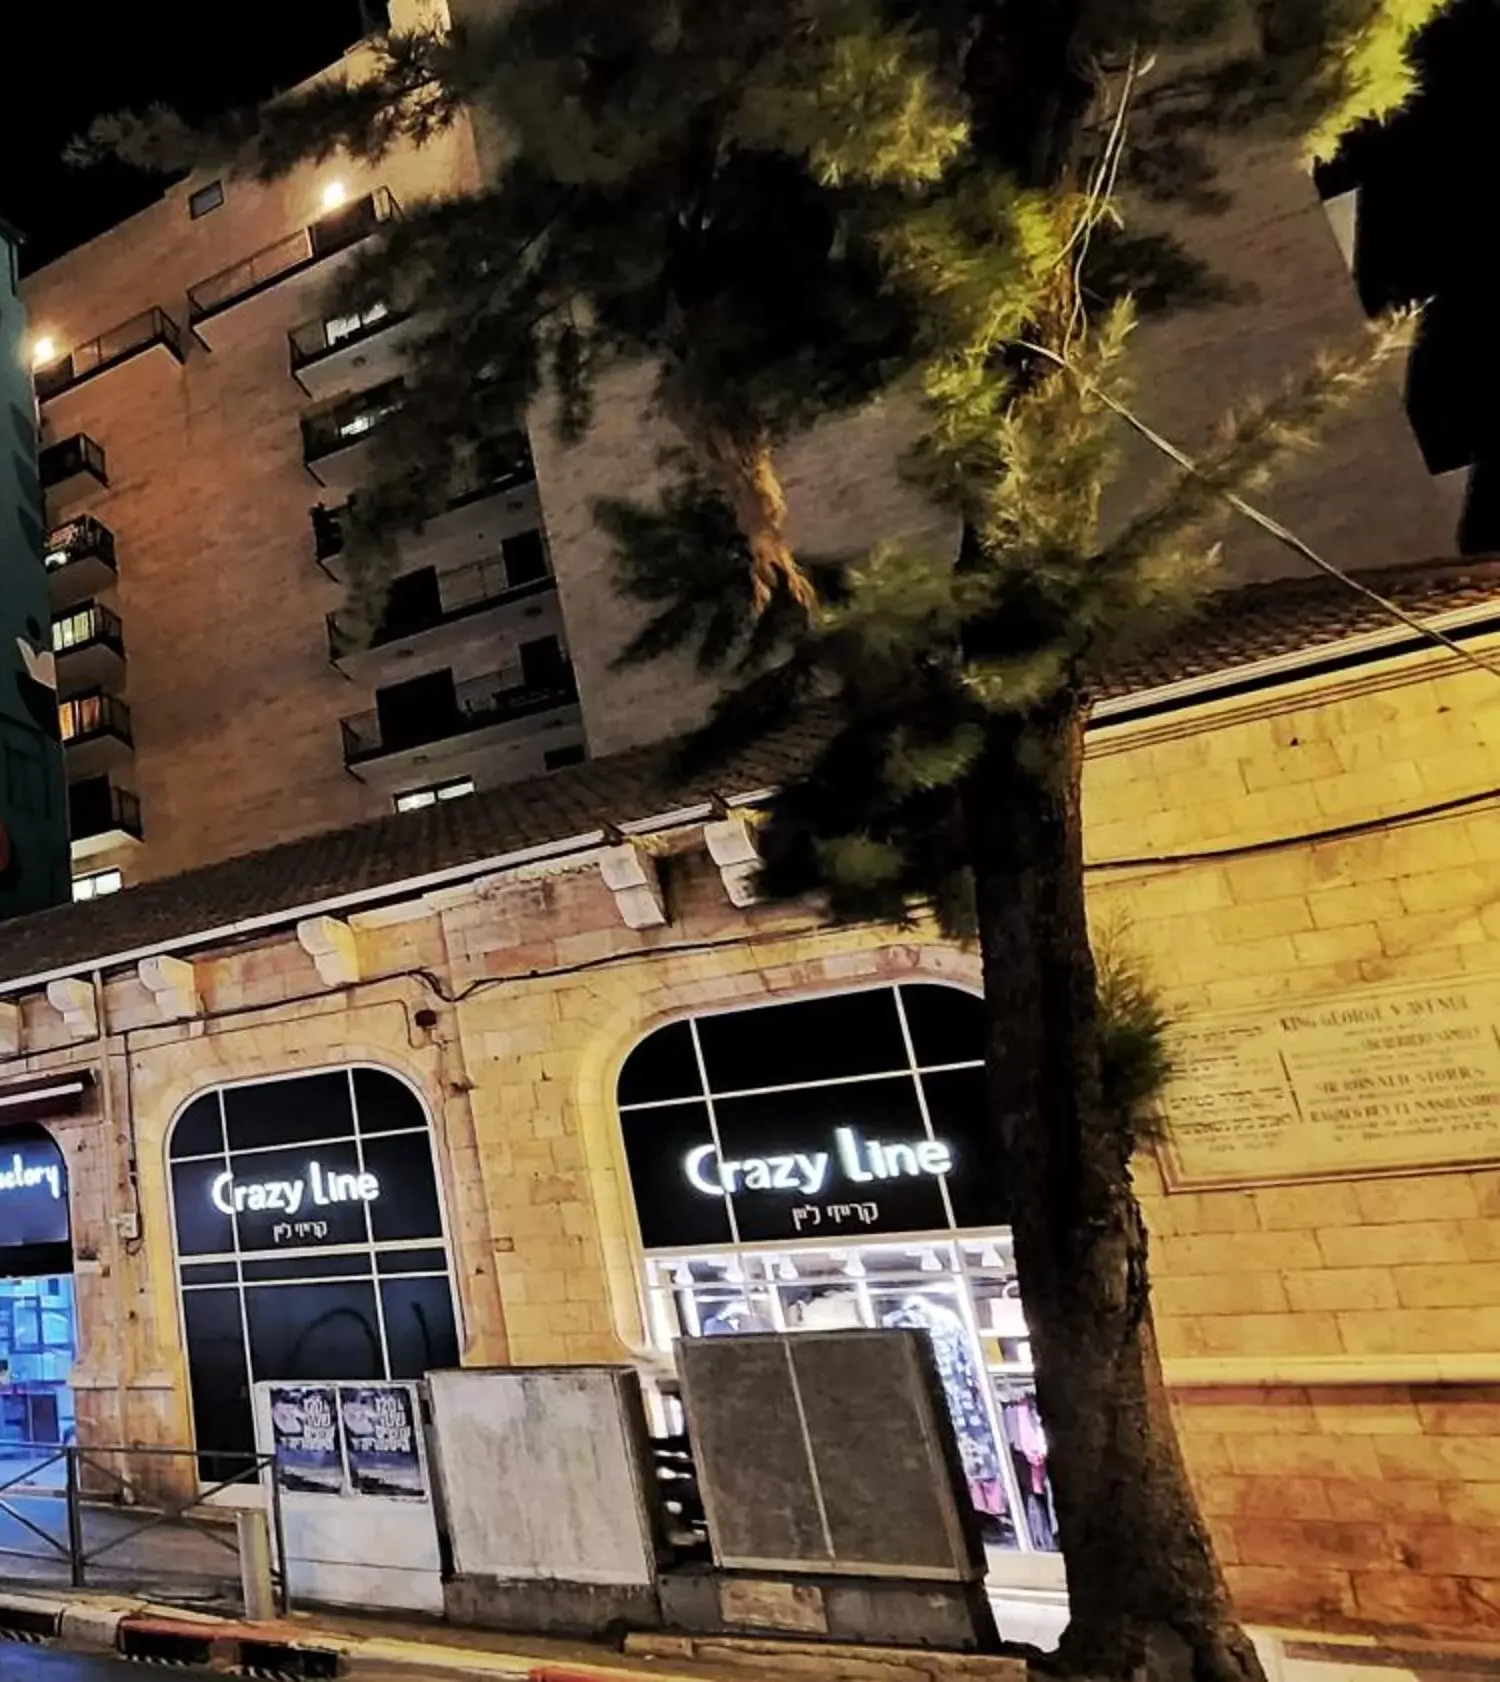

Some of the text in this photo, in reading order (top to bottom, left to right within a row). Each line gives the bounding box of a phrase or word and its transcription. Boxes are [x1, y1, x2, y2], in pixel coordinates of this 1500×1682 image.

[211, 1160, 381, 1215] Crazy Line
[684, 1126, 954, 1196] Crazy Line
